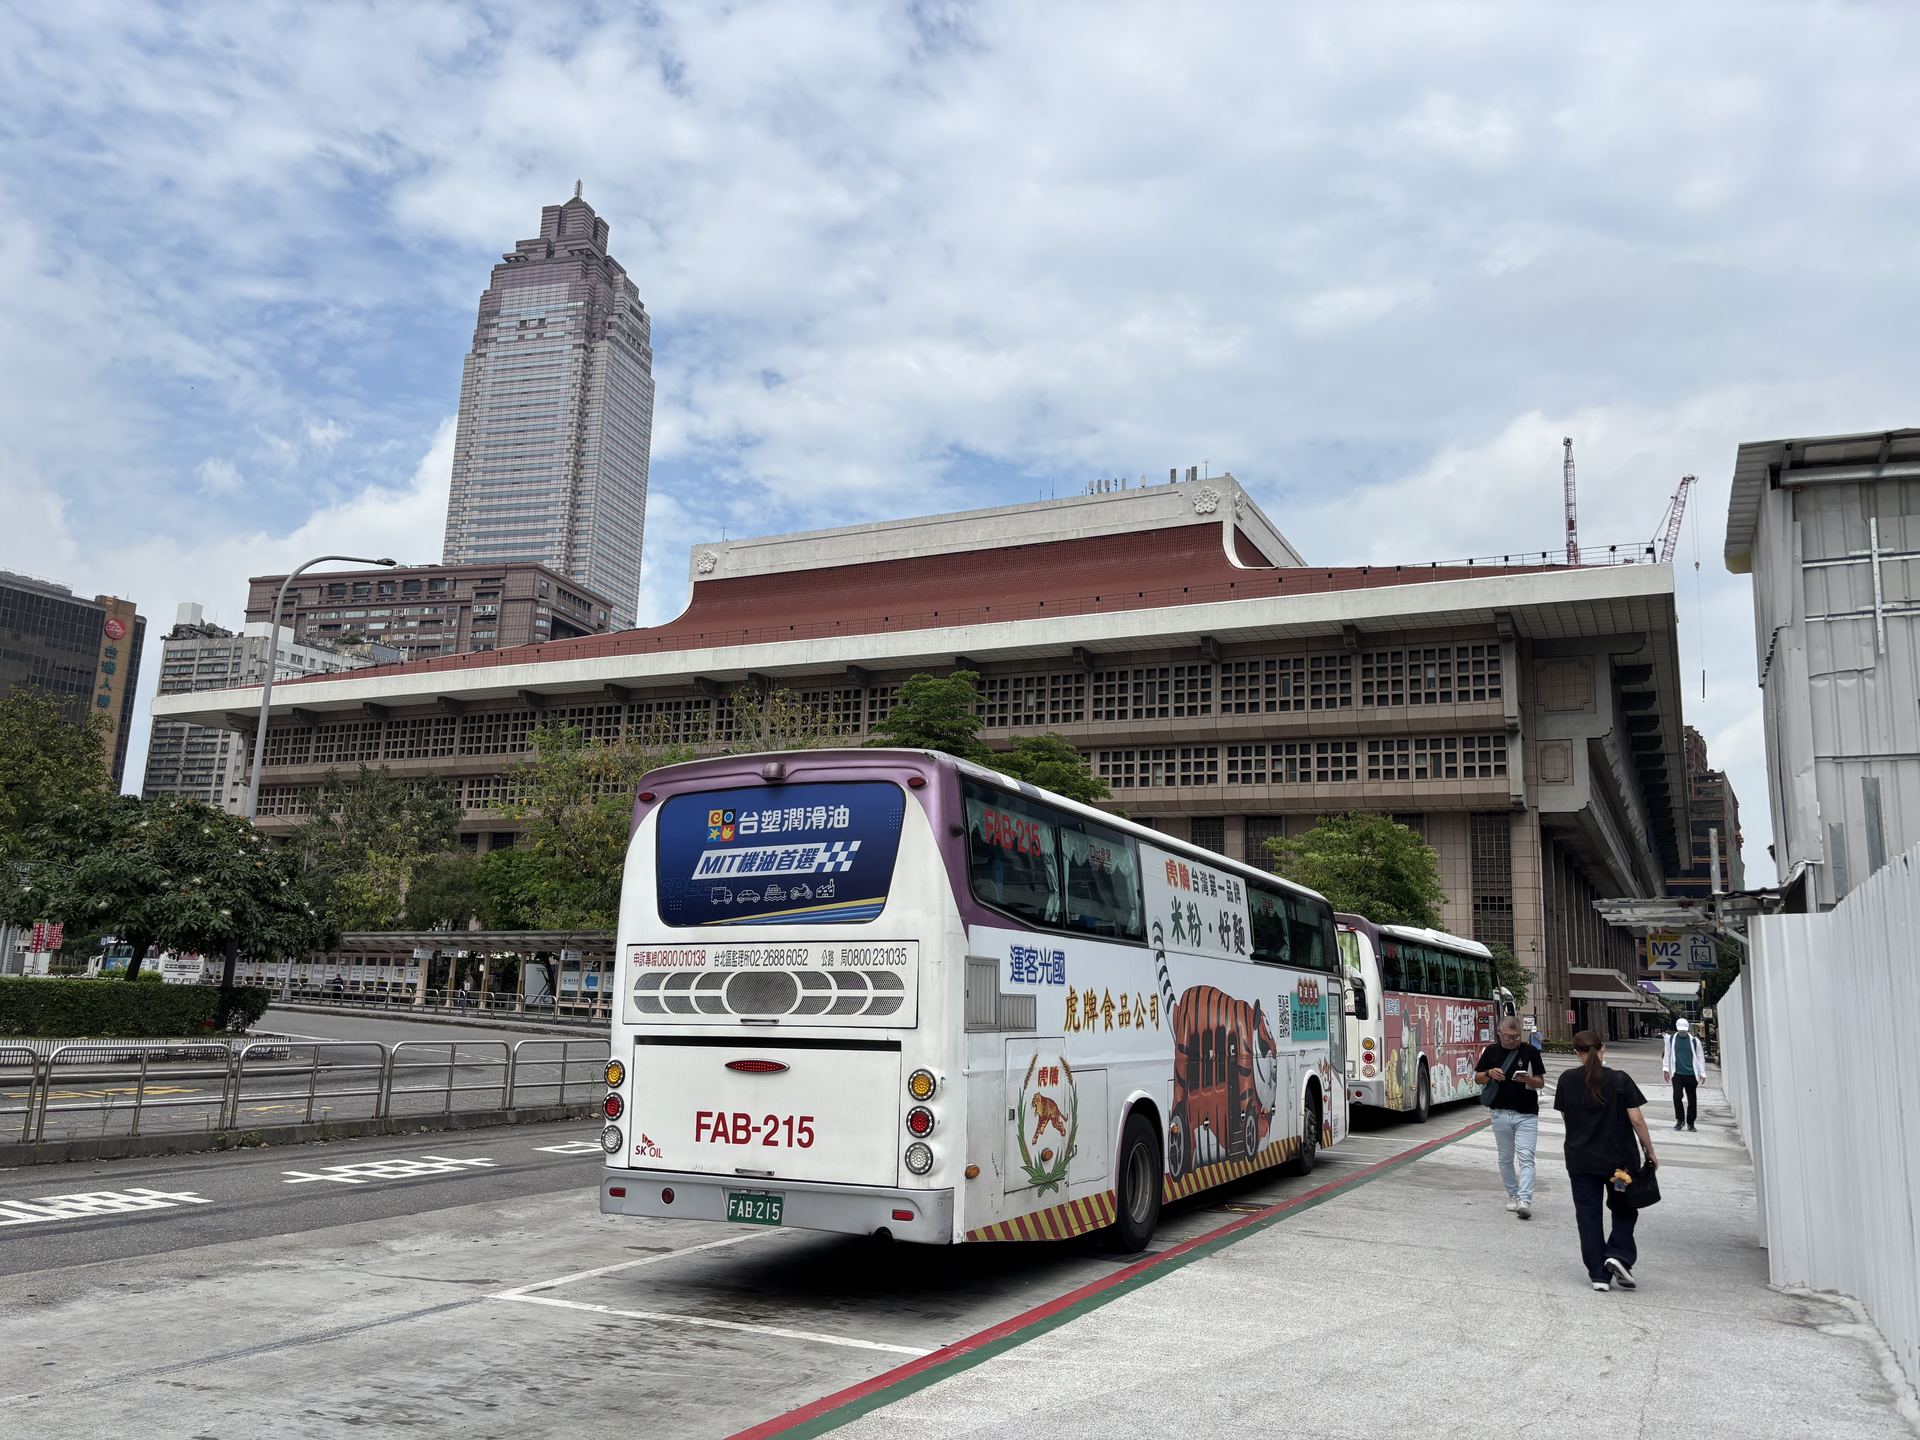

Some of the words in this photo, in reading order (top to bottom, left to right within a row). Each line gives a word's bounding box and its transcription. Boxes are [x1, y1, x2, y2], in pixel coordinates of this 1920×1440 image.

[739, 804, 850, 835] 台塑潤滑油
[984, 808, 1041, 858] FAB-215
[699, 847, 820, 876] MIT機油首選
[1651, 941, 1682, 957] M2
[1064, 985, 1160, 1034] 虎牌食品公司
[1038, 1066, 1059, 1088] 虎牌
[694, 1110, 815, 1149] FAB-215
[635, 1145, 647, 1156] SK
[649, 1147, 663, 1159] OIL
